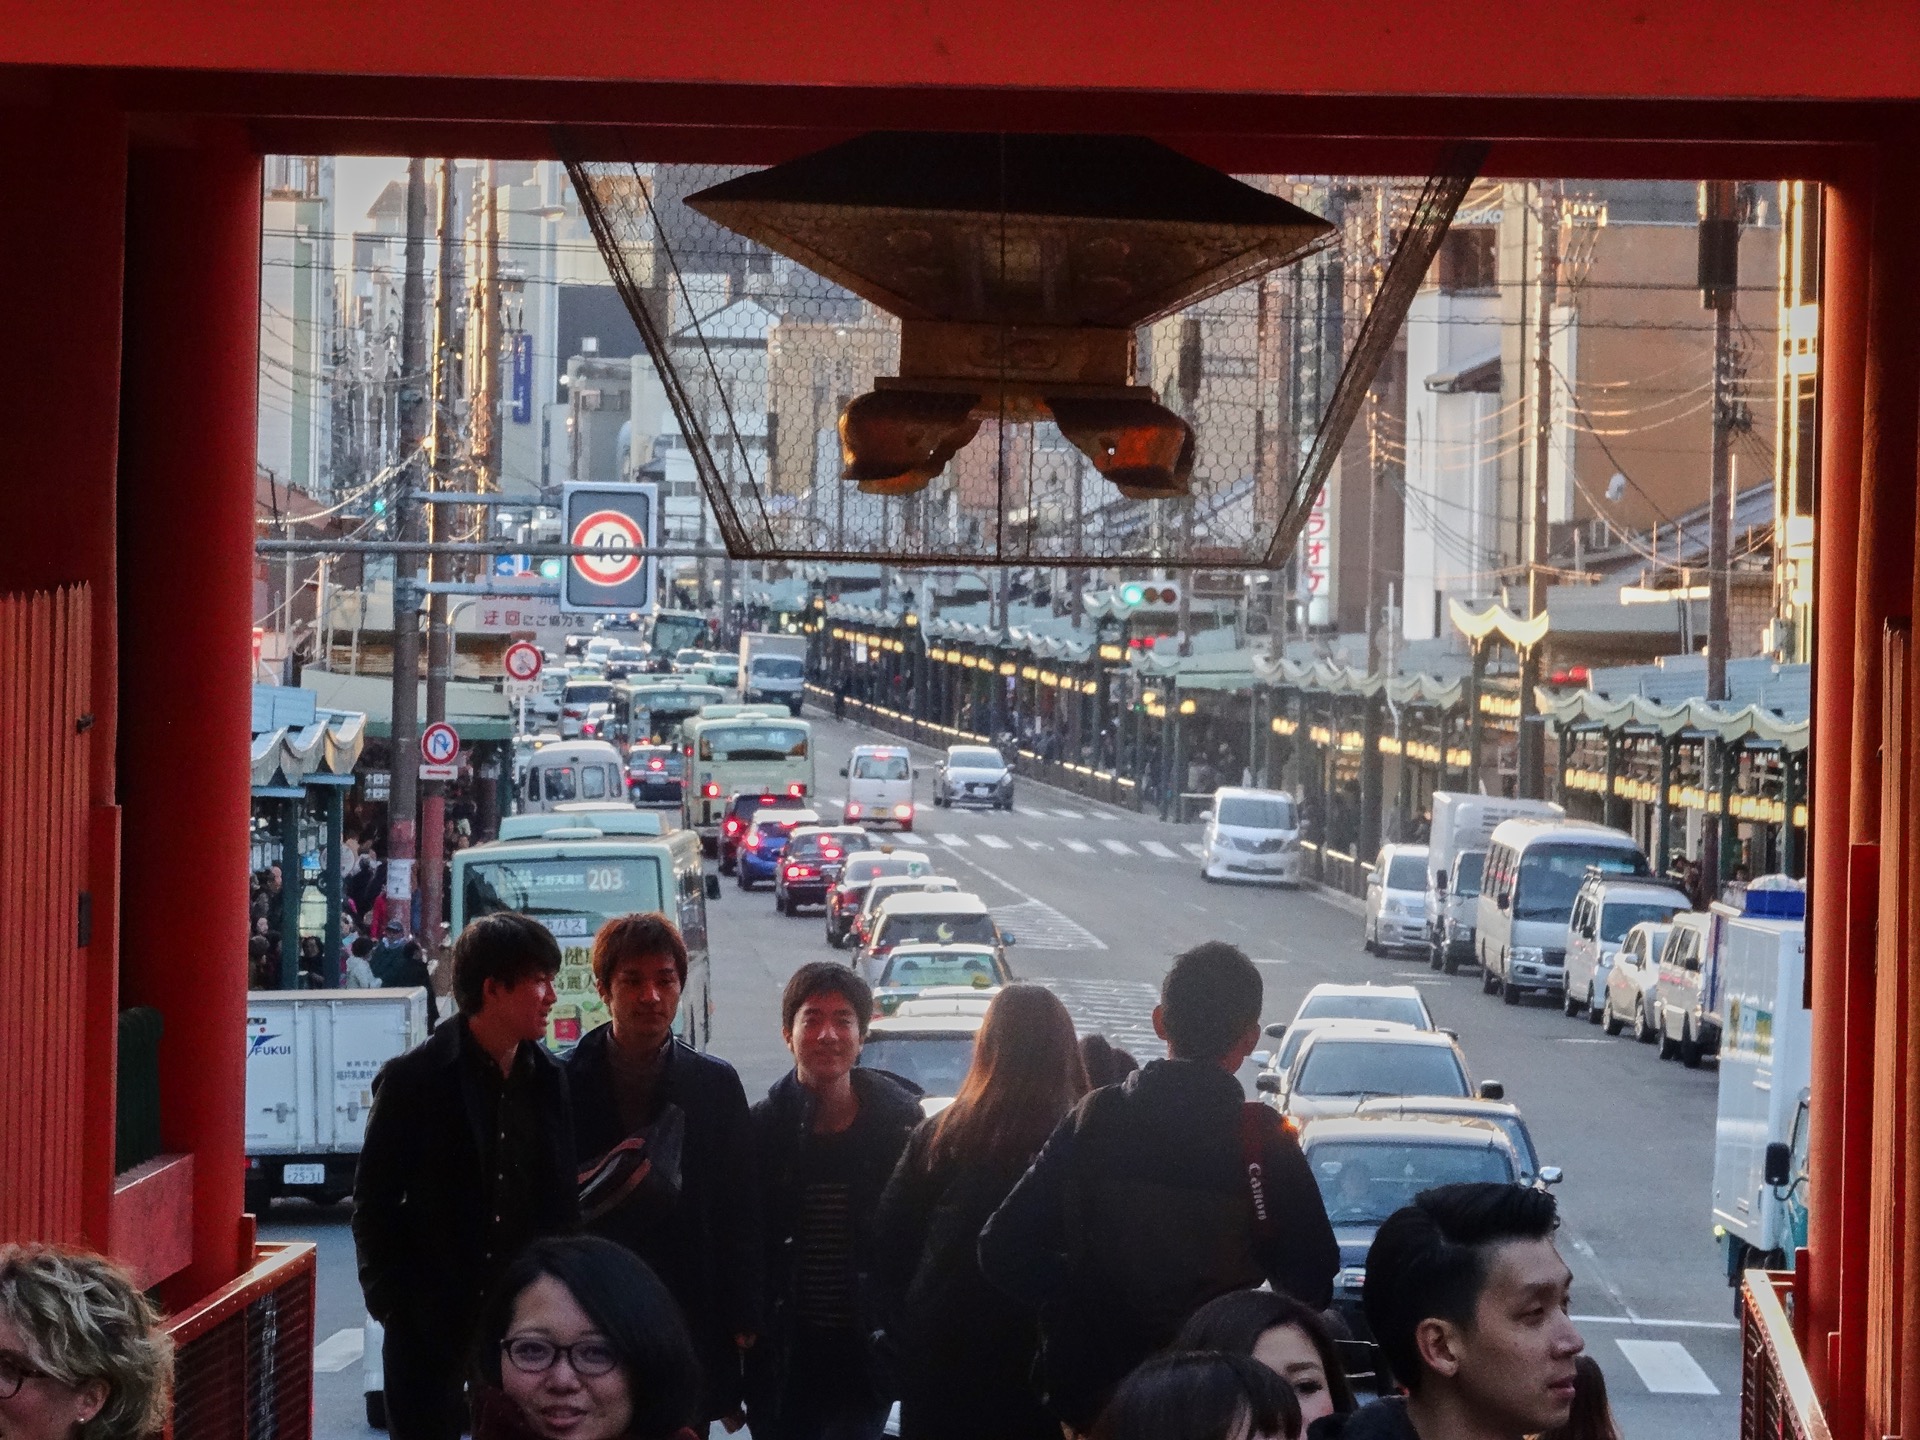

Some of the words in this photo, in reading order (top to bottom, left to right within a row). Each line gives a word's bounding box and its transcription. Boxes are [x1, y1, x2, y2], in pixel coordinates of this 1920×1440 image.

[593, 532, 627, 564] 40
[587, 867, 624, 891] 203
[254, 1046, 291, 1056] FUKUI
